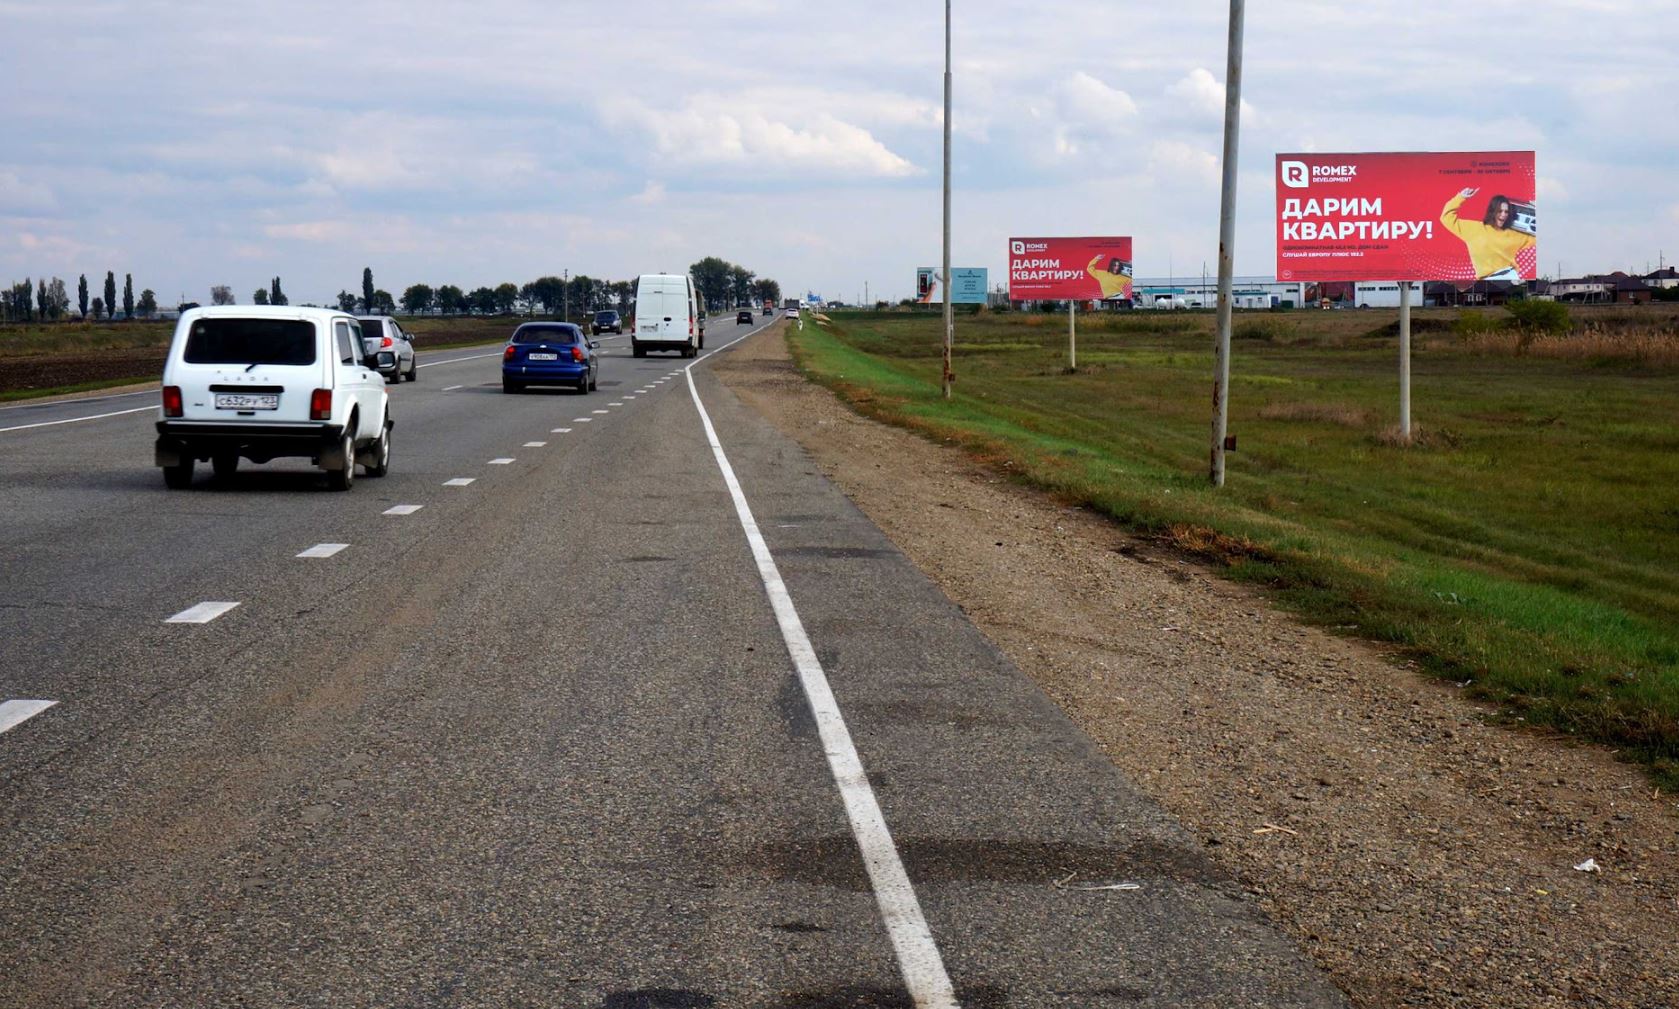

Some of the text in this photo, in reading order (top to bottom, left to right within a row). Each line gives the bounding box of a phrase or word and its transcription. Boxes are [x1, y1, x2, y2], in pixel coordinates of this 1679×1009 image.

[1312, 165, 1357, 176] ROMEX
[1282, 198, 1382, 220] ДАРИМ
[1283, 221, 1433, 240] КВАРТИРУ!
[1012, 259, 1060, 270] ДАРИМ
[1012, 270, 1084, 280] КВАРТИРУ!
